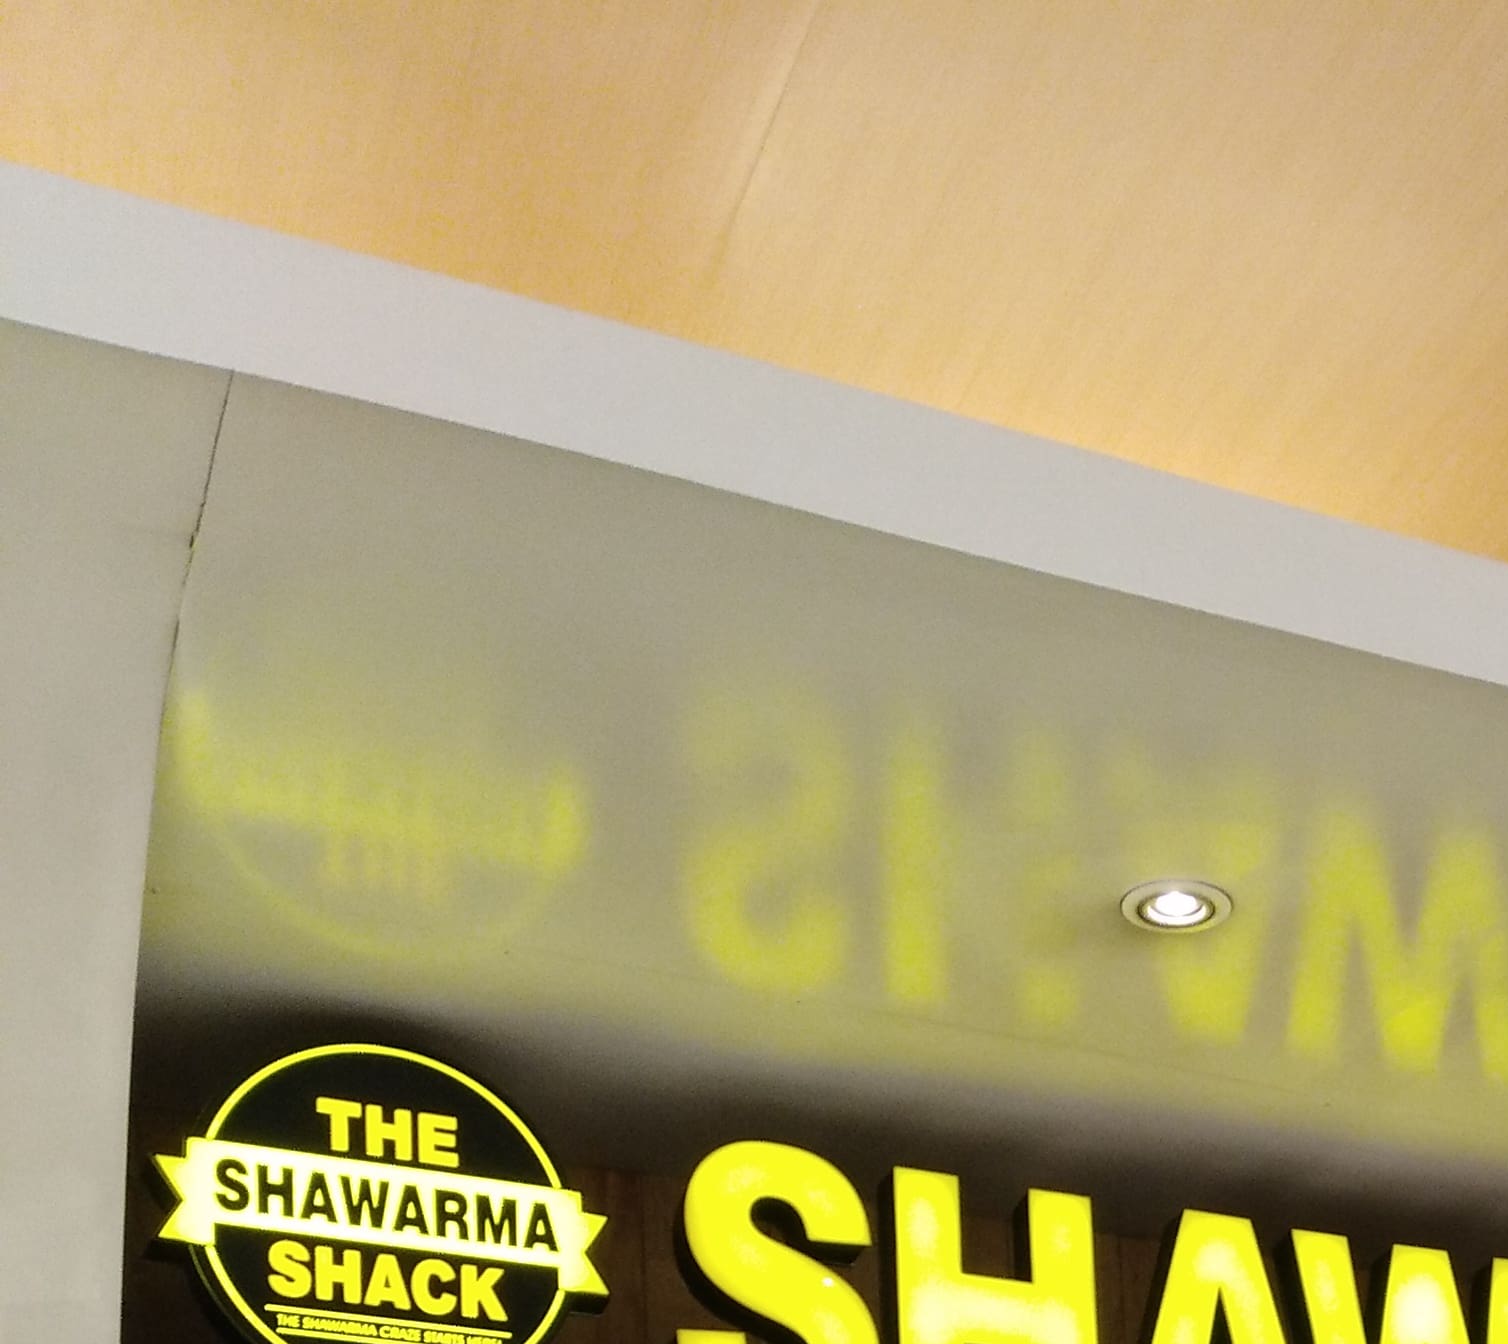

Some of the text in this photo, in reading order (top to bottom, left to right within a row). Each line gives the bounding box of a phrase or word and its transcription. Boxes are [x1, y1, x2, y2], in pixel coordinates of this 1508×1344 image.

[316, 1097, 460, 1167] THE
[215, 1158, 561, 1253] SHAWARMA
[267, 1240, 508, 1322] SHACK
[276, 1314, 300, 1328] THE
[302, 1316, 377, 1337] SHAWARMA
